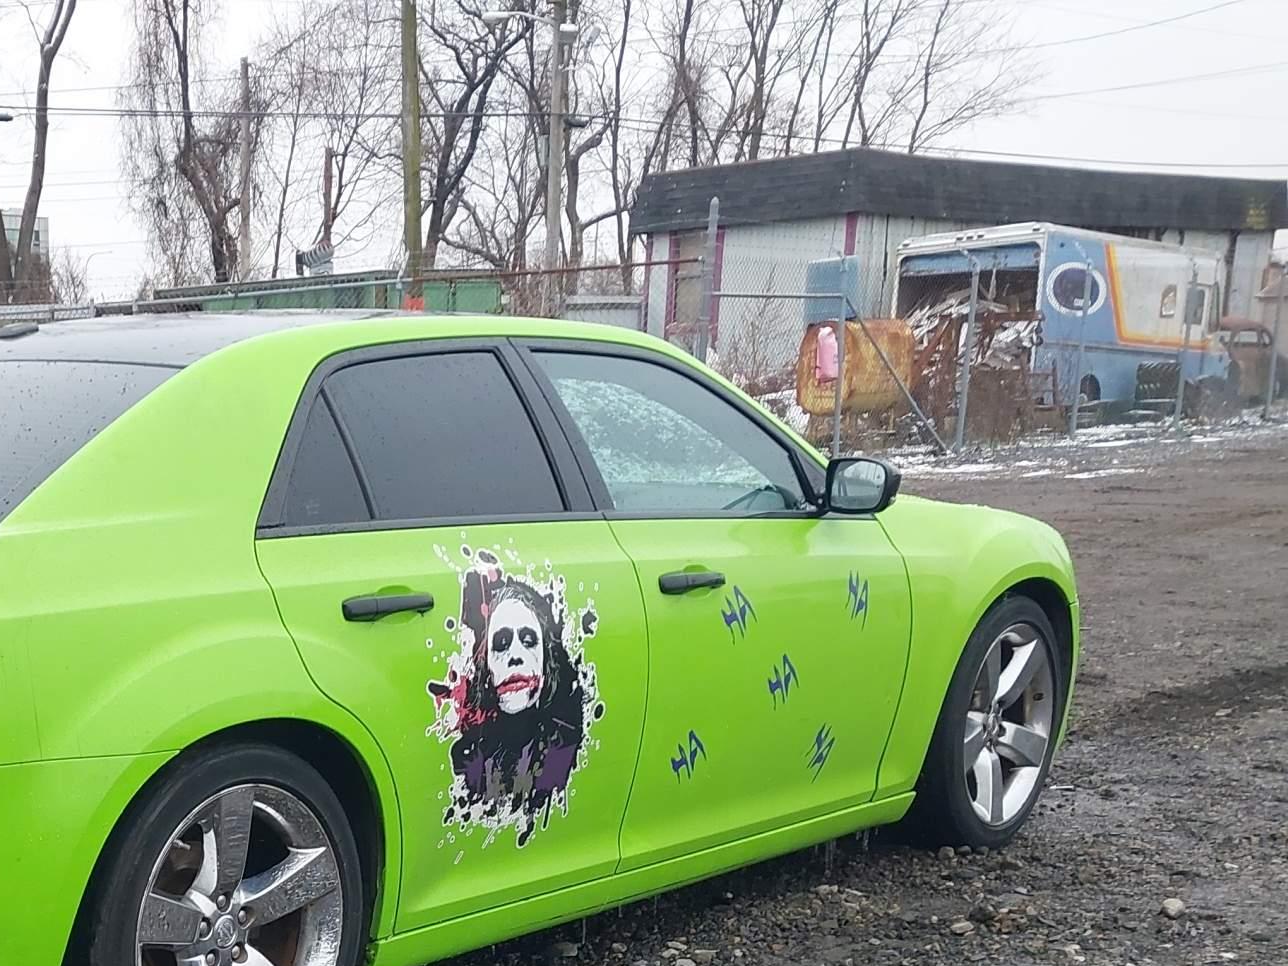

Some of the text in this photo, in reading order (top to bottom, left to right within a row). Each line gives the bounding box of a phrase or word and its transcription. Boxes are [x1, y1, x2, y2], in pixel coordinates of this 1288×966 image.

[721, 585, 758, 645] HA
[768, 653, 800, 711] HA
[671, 730, 707, 784] HA
